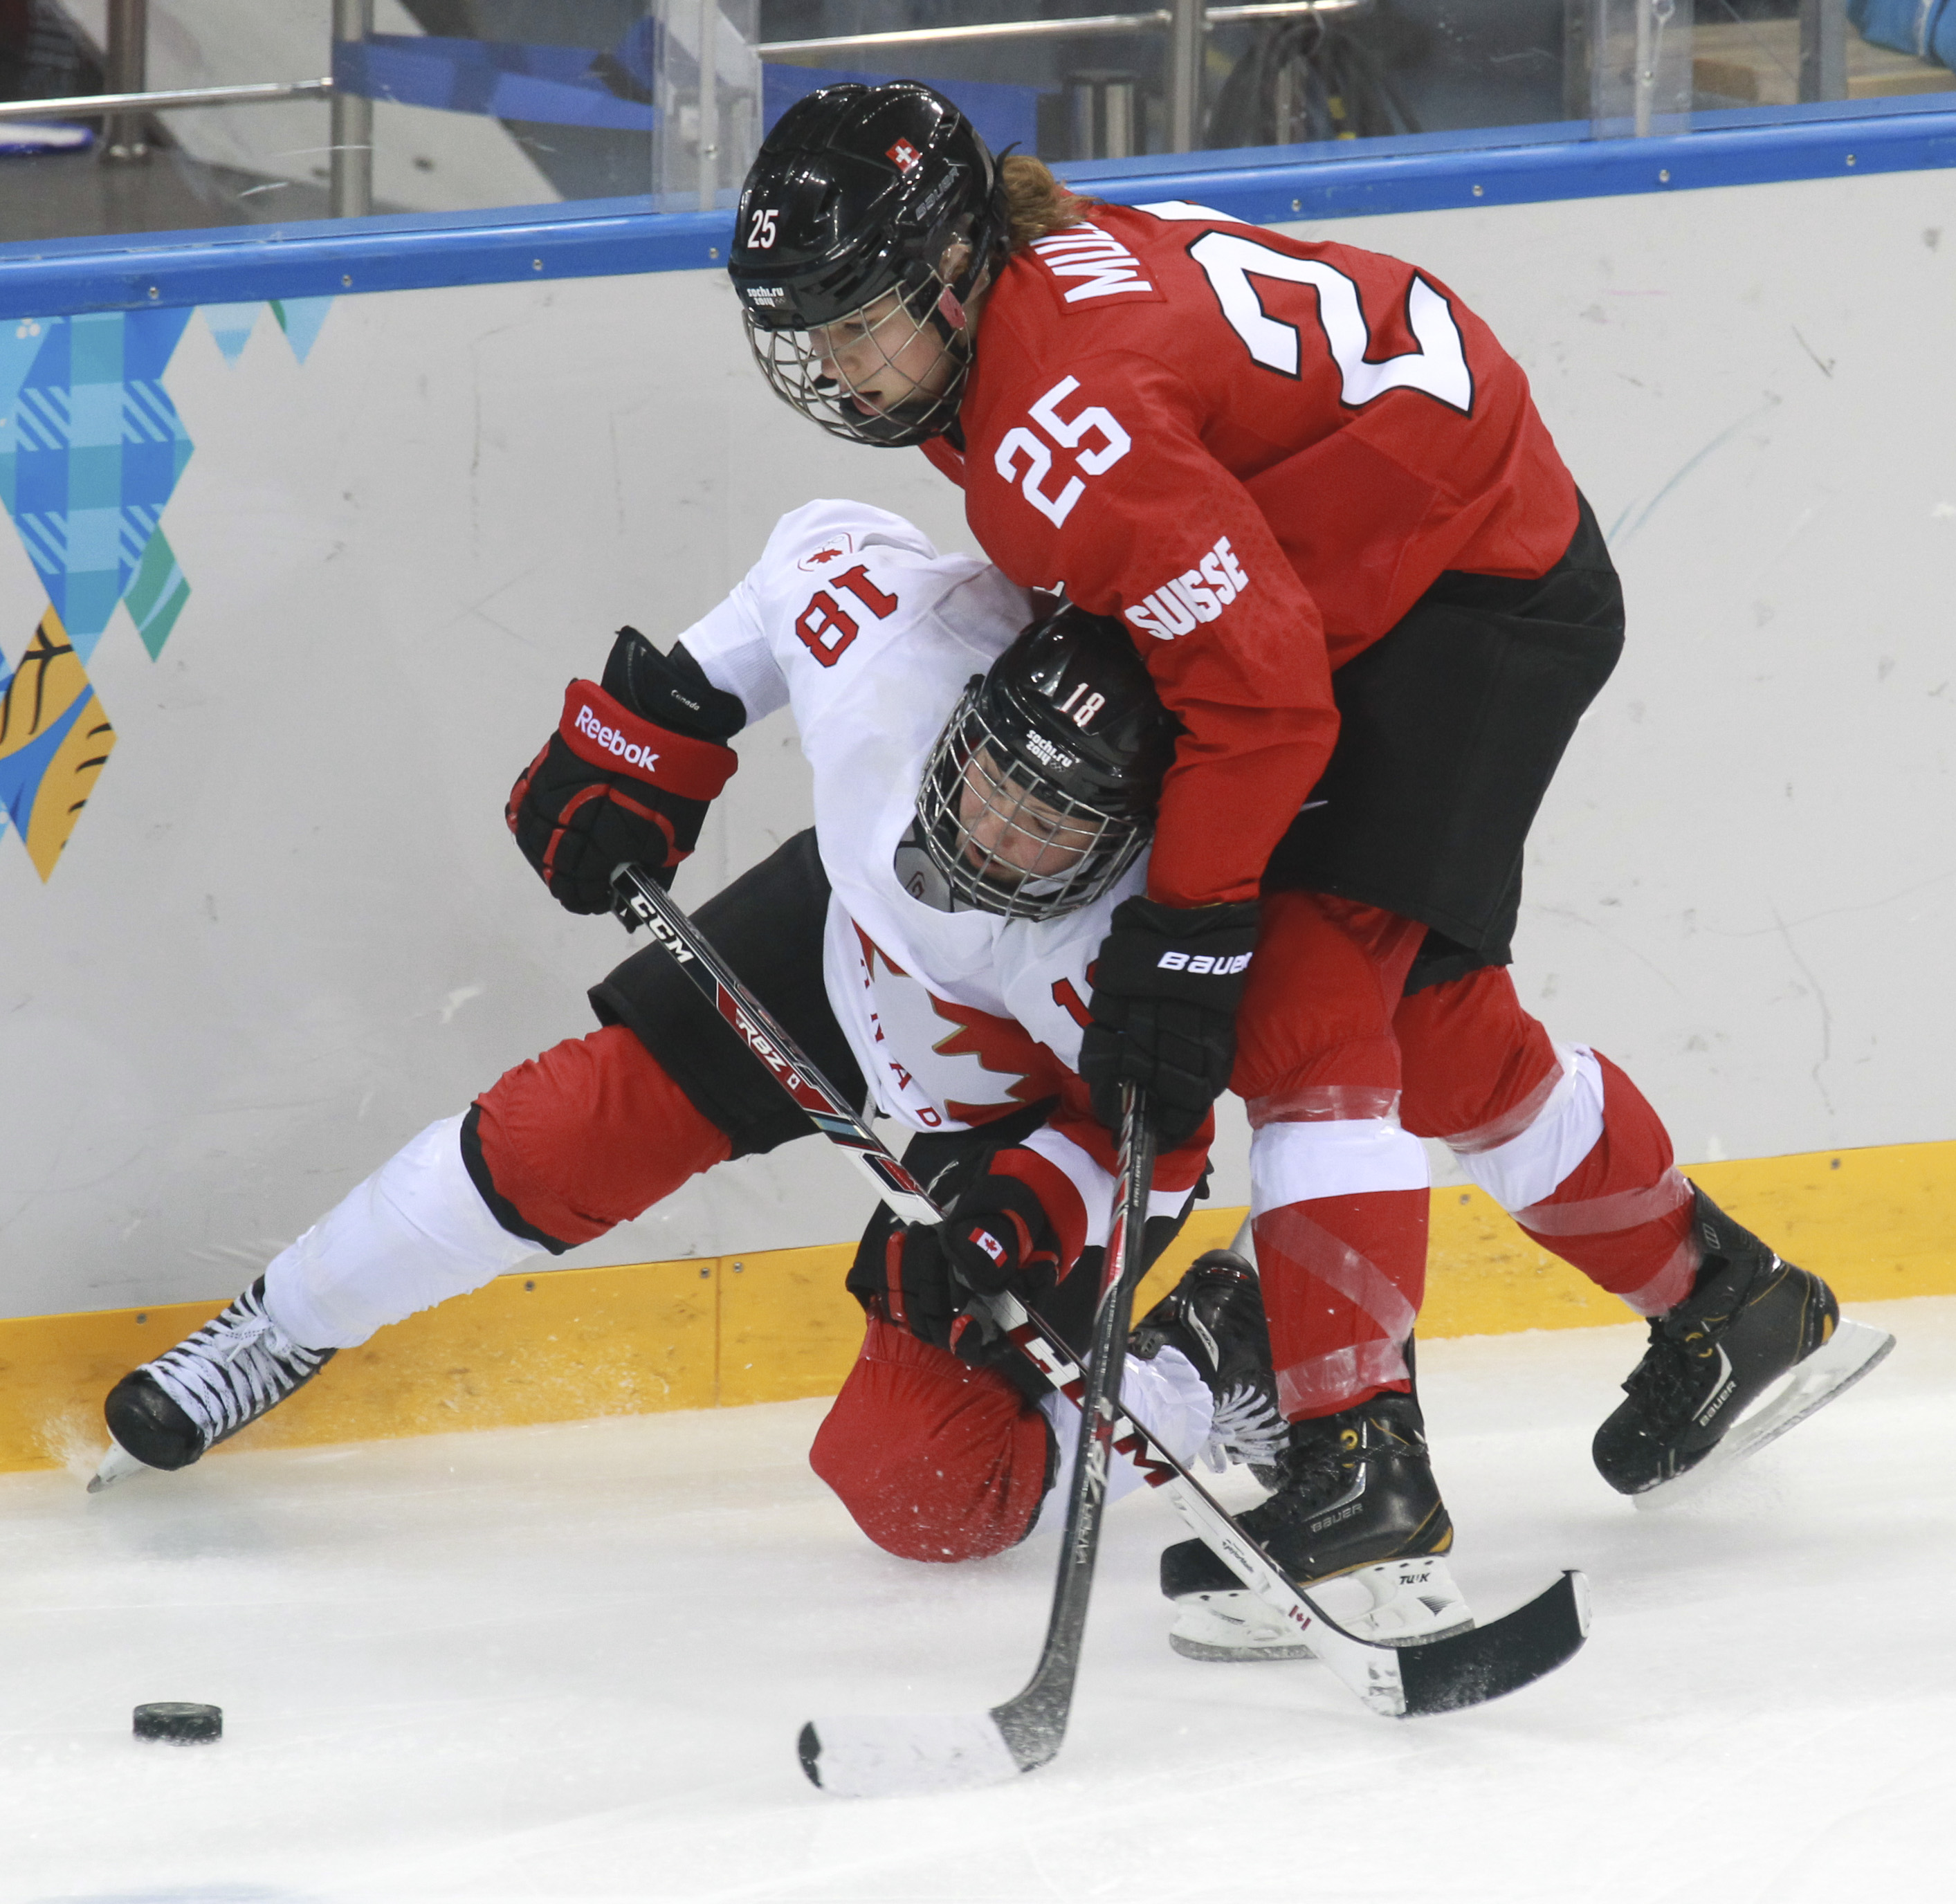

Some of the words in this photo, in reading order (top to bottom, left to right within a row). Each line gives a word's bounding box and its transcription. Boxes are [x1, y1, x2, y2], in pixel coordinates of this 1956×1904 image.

[747, 210, 779, 249] 25
[747, 286, 785, 298] sochi.ru
[1129, 198, 1474, 419] 2
[994, 375, 1132, 529] 25
[795, 564, 898, 668] 18
[1124, 536, 1250, 641] SUISSE
[670, 689, 700, 711] Canada
[1059, 682, 1106, 728] 18
[575, 704, 660, 772] Reebok
[1025, 740, 1052, 766] 2014
[1026, 729, 1073, 767] sochi.ru
[630, 891, 694, 964] CCM
[1050, 958, 1103, 1031] 1
[735, 1007, 788, 1073] RBZ
[1699, 1380, 1737, 1427] BAUER
[1310, 1503, 1364, 1533] BAUER
